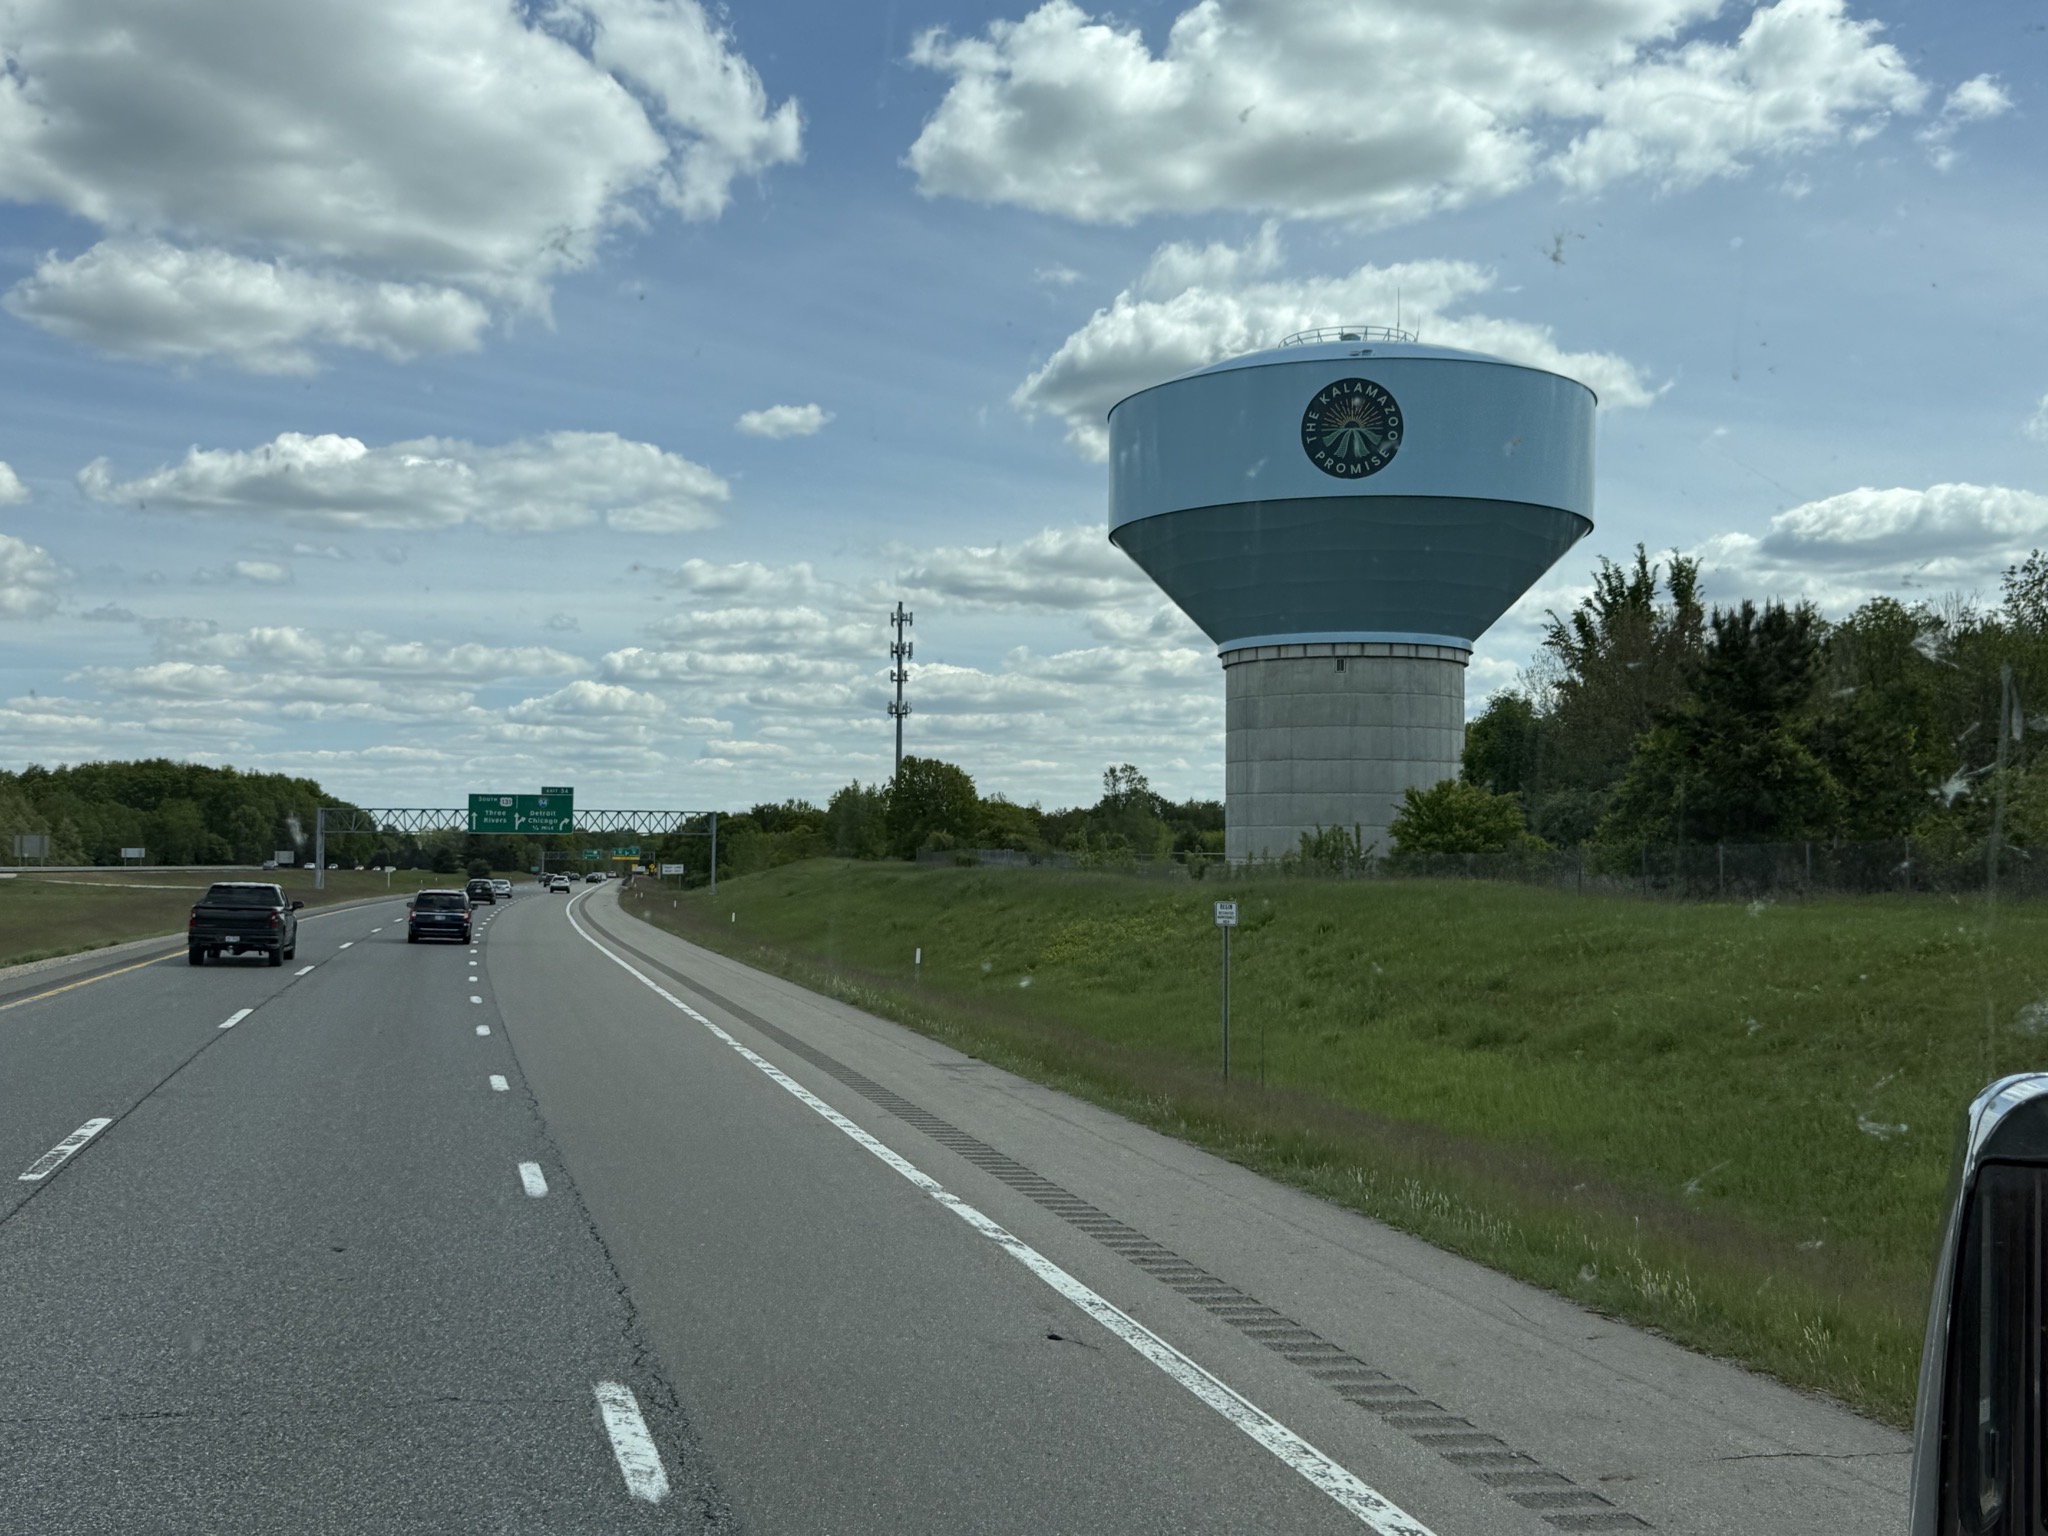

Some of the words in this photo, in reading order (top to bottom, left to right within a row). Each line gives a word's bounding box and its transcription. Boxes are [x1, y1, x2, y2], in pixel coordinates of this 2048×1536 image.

[1306, 411, 1319, 444] THE
[1319, 383, 1398, 440] KALAMAZOO
[1315, 448, 1389, 474] PROMISE
